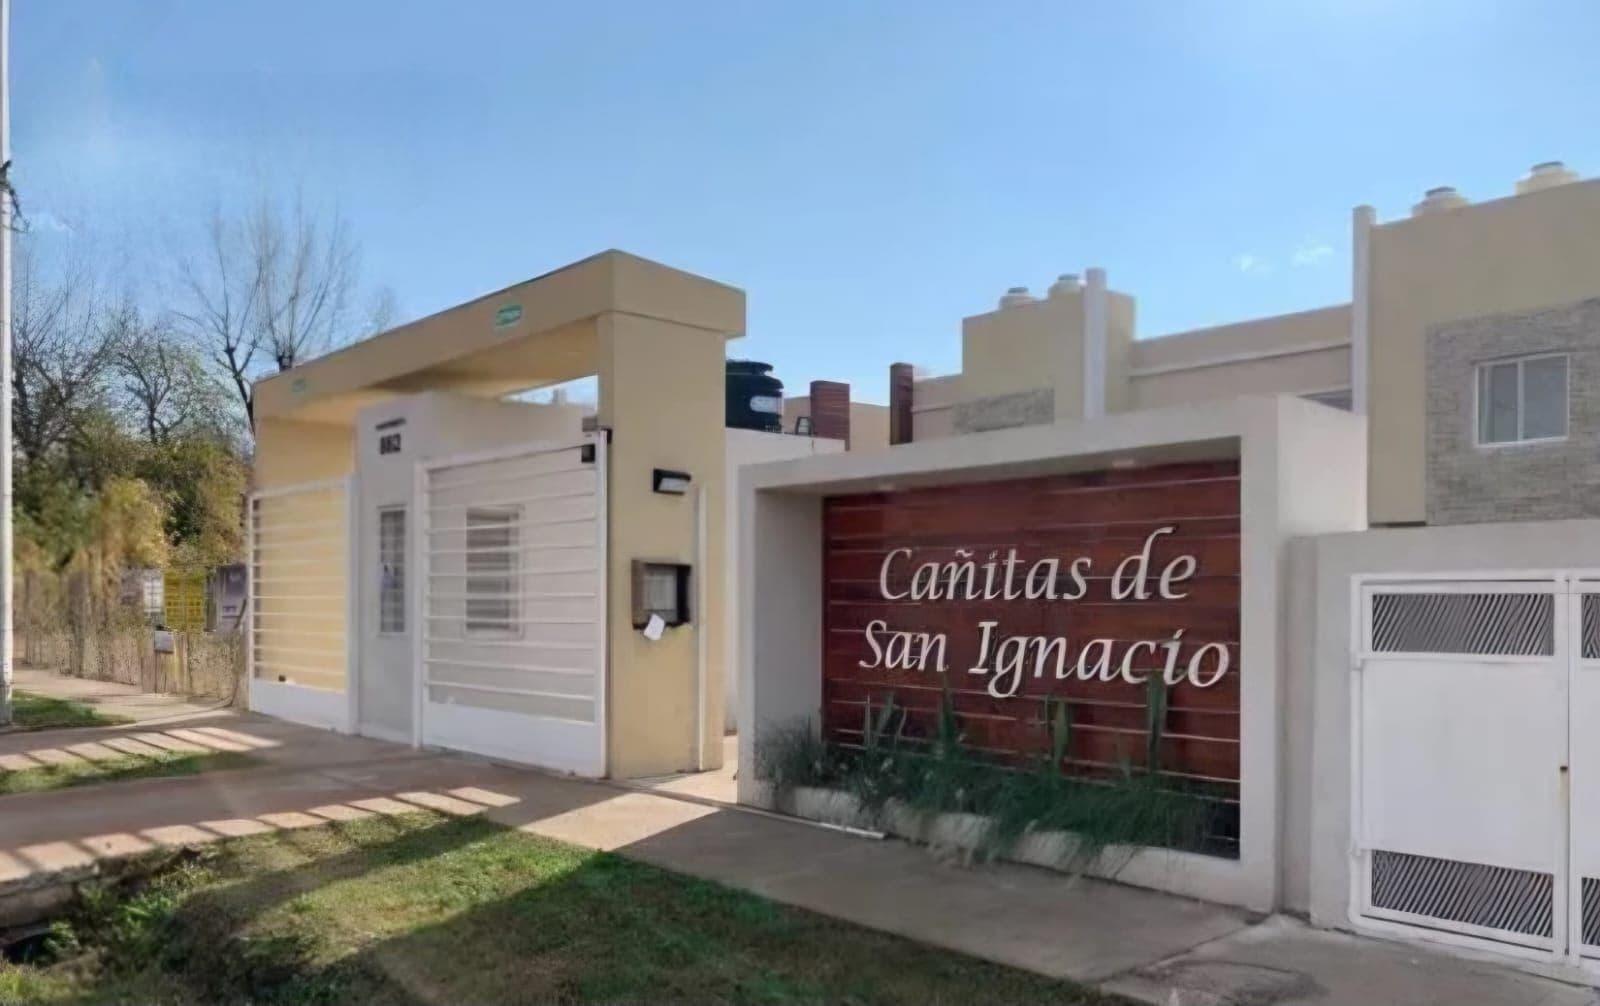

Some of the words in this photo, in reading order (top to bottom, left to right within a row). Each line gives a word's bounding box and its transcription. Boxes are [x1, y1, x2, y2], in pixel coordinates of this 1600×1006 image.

[879, 548, 1092, 600] Cañitas
[1110, 526, 1197, 600] de
[858, 619, 948, 673] San
[967, 620, 1230, 699] Ignacio
